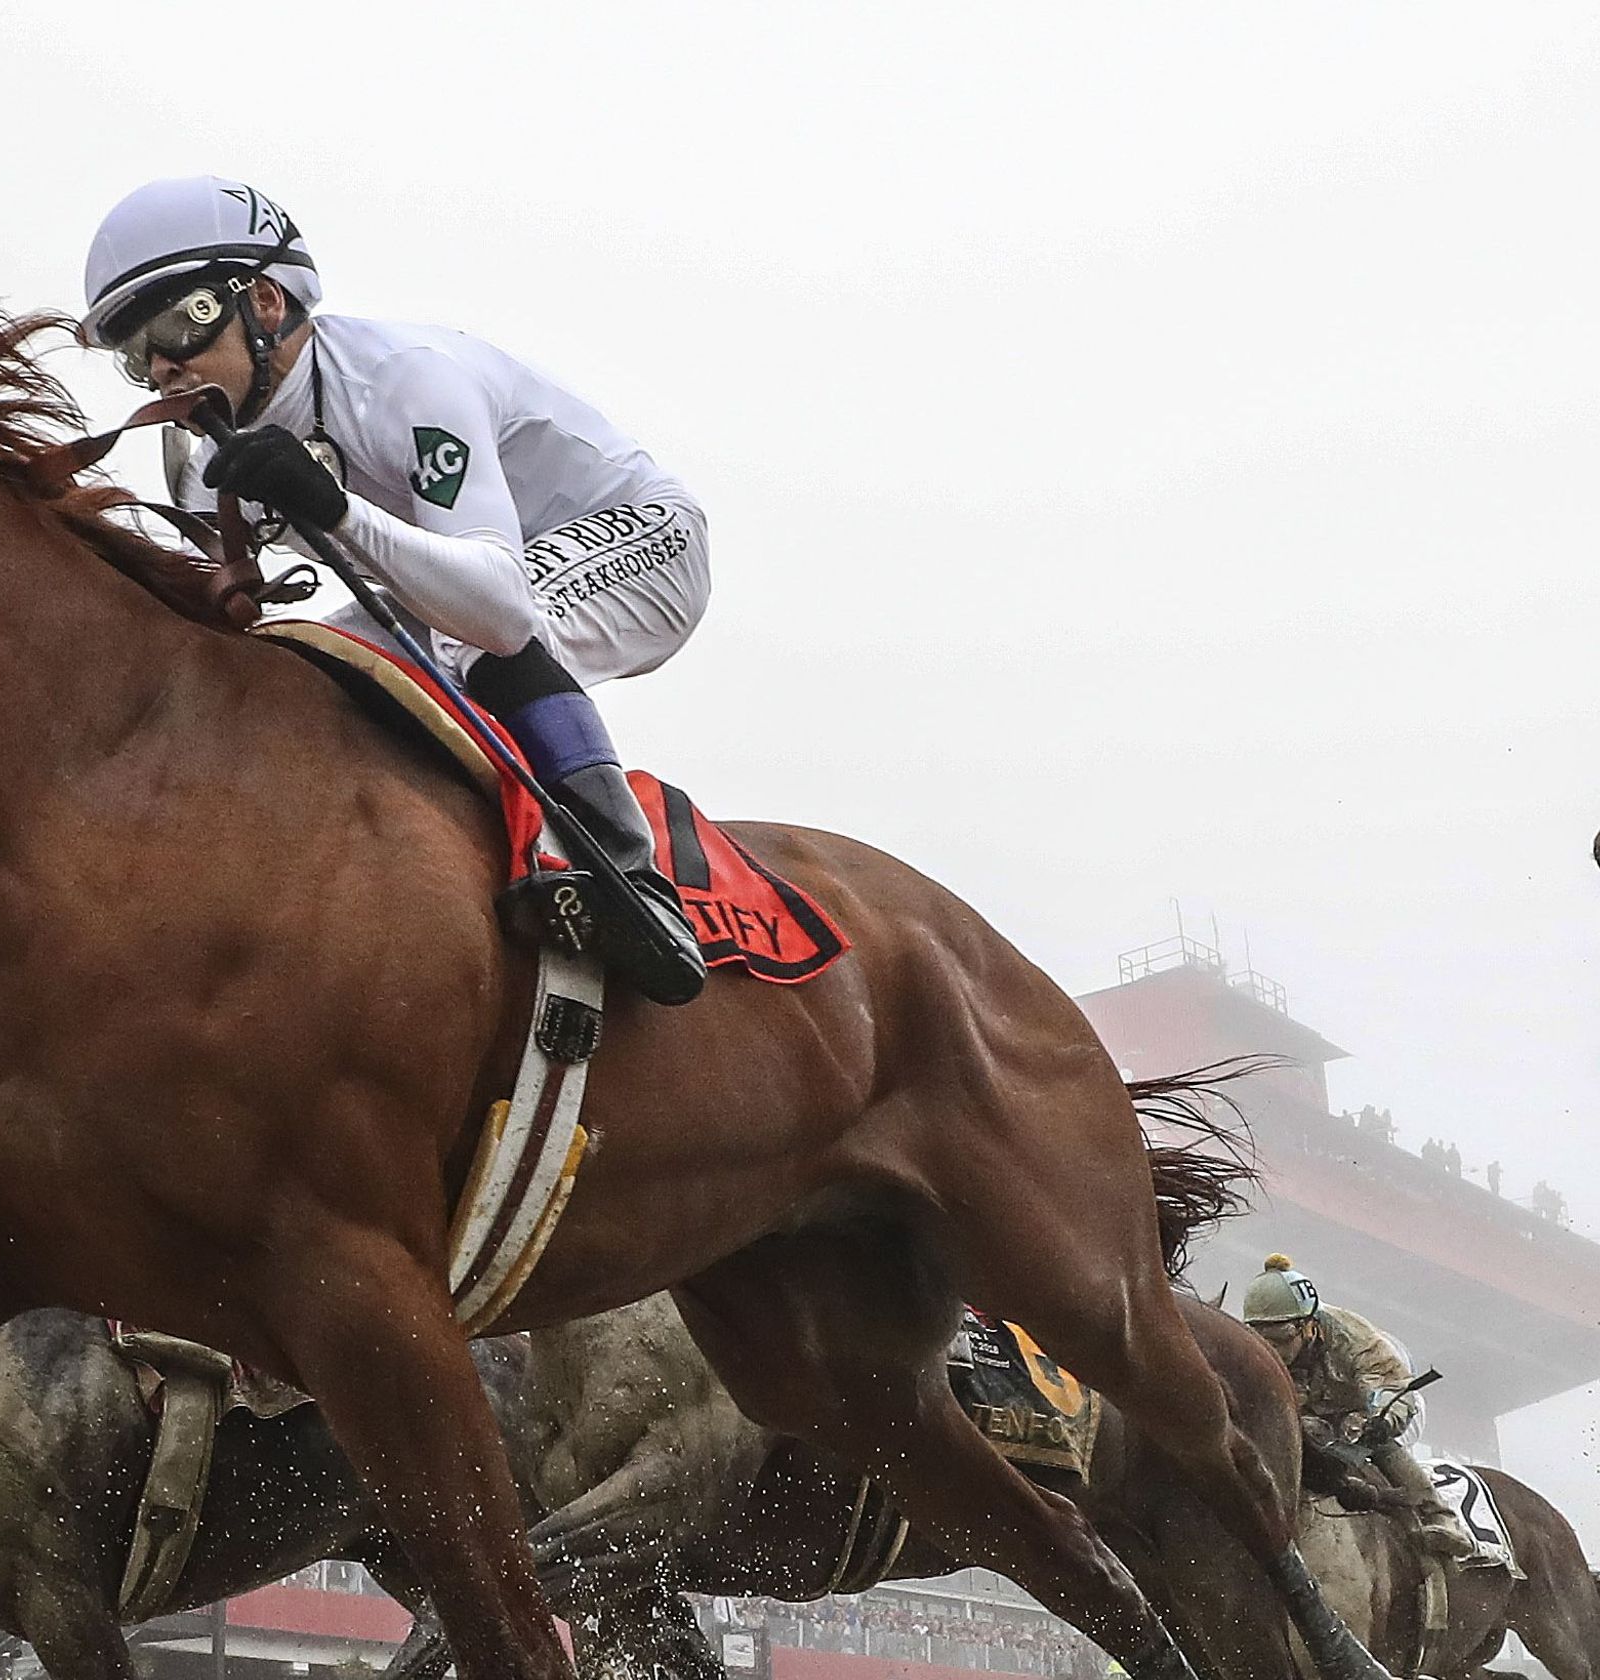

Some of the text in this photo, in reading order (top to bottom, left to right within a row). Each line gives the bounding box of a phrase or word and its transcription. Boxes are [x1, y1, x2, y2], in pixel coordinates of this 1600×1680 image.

[549, 528, 688, 619] STEAKHOUSES
[684, 898, 781, 957] TIFY
[1289, 1279, 1317, 1301] TB
[1433, 1464, 1501, 1545] 2
